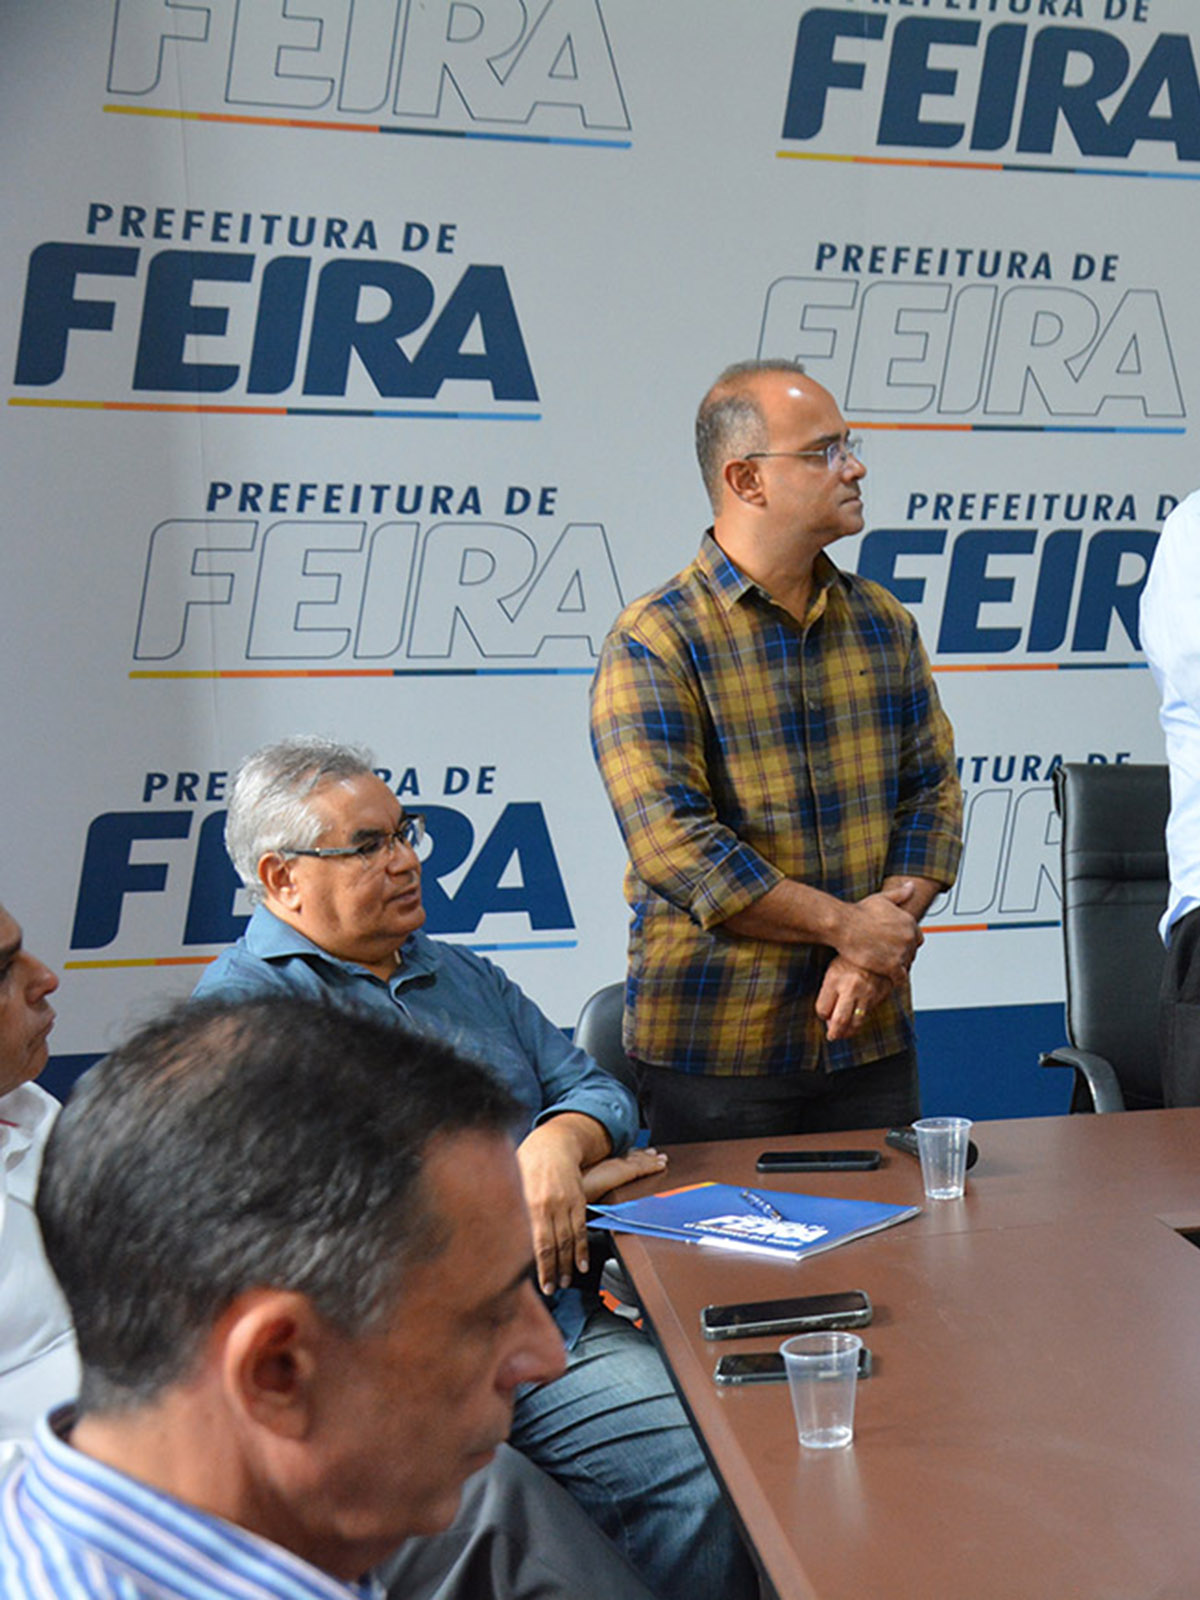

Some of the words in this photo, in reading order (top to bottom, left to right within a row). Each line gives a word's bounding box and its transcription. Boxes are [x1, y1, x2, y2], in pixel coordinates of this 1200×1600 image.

[107, 0, 632, 131] FEIRA
[86, 202, 378, 251] PREFEITURA
[402, 222, 458, 254] DE
[814, 242, 1052, 281] PREFEITURA
[1072, 253, 1119, 282] DE
[13, 241, 540, 402] FEIRA
[757, 276, 1187, 418] FEIRA
[205, 481, 482, 515] PREFEITURA
[504, 486, 558, 516] DE
[906, 493, 1137, 521] PREFEITURA
[133, 519, 625, 660] FEIRA
[857, 529, 1162, 654] FEIR
[443, 766, 497, 795] DE
